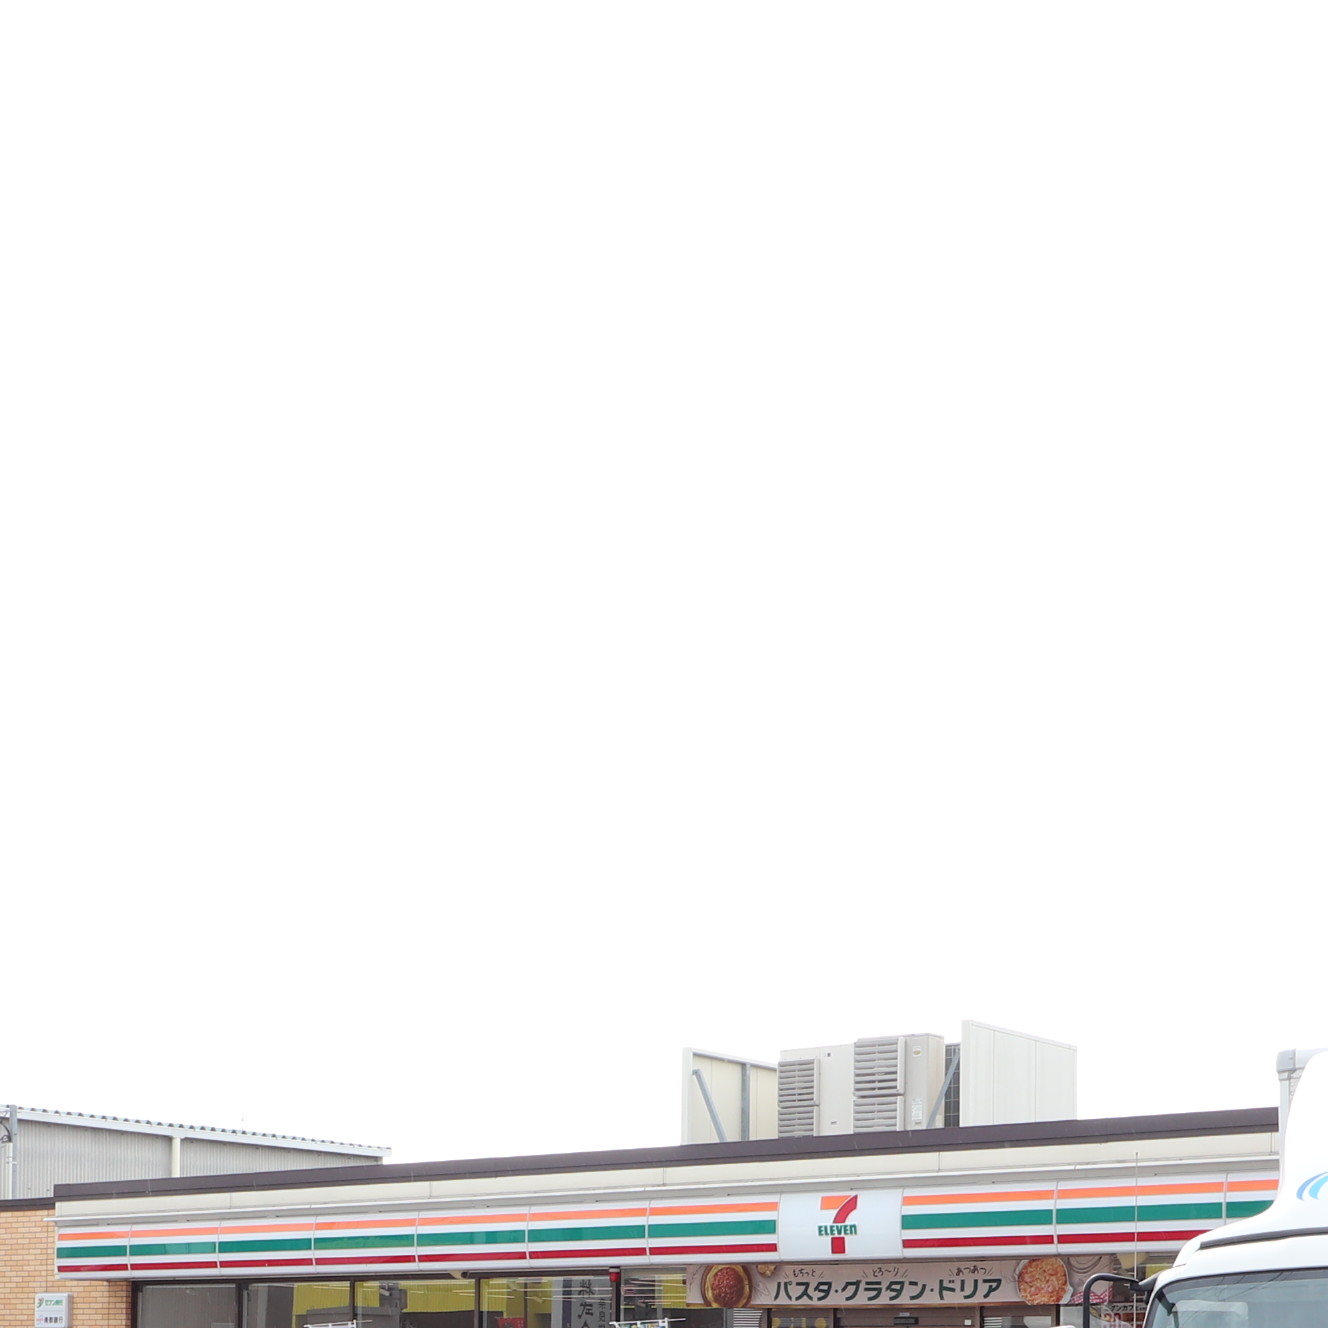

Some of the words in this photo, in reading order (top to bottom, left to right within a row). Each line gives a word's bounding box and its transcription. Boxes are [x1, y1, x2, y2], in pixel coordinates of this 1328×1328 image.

[792, 1268, 816, 1278] もちっと
[955, 1266, 987, 1276] あつあつ
